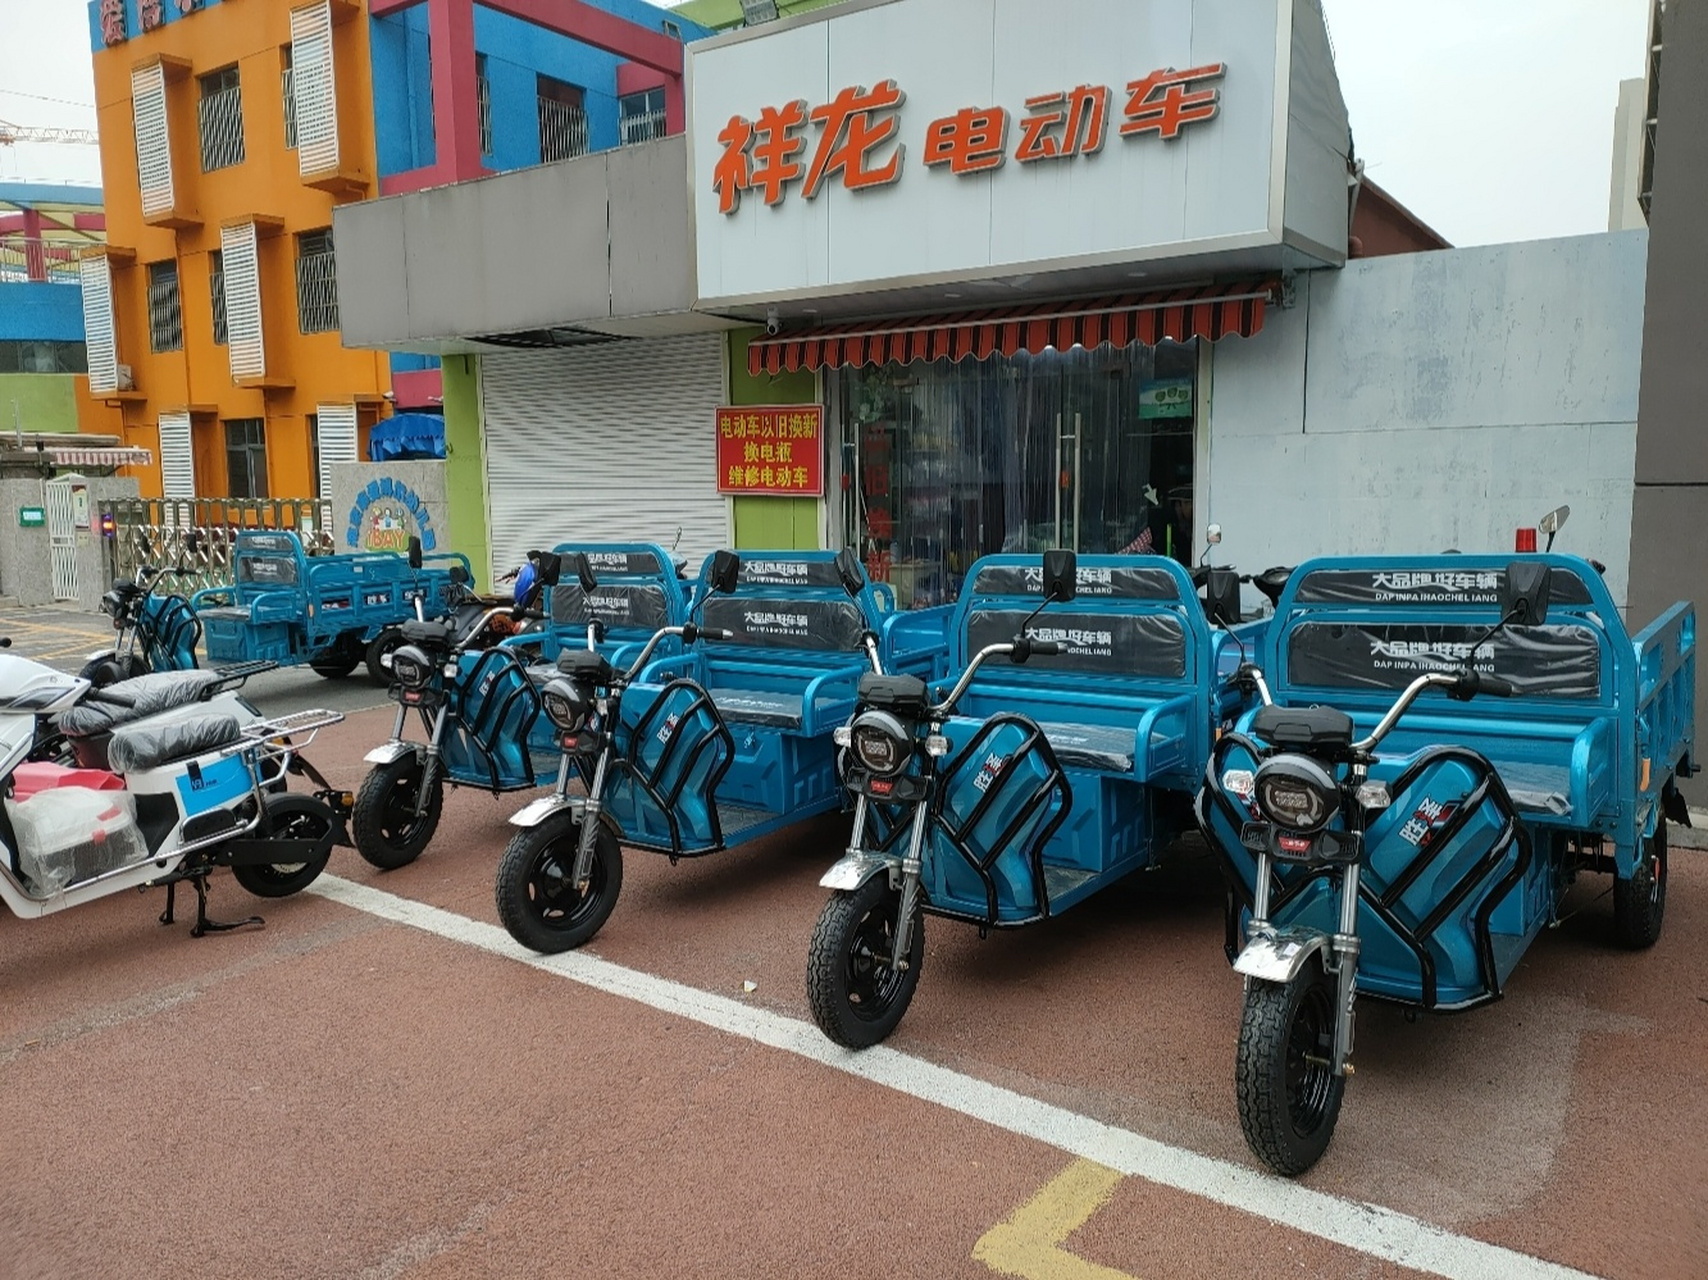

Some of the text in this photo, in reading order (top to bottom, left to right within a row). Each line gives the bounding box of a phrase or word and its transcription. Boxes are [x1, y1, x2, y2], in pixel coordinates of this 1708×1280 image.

[713, 62, 1227, 215] 祥龙电动车
[720, 413, 818, 438] 电动车以旧换新
[744, 441, 793, 462] 换电瓶
[728, 465, 808, 488] 维修电动车
